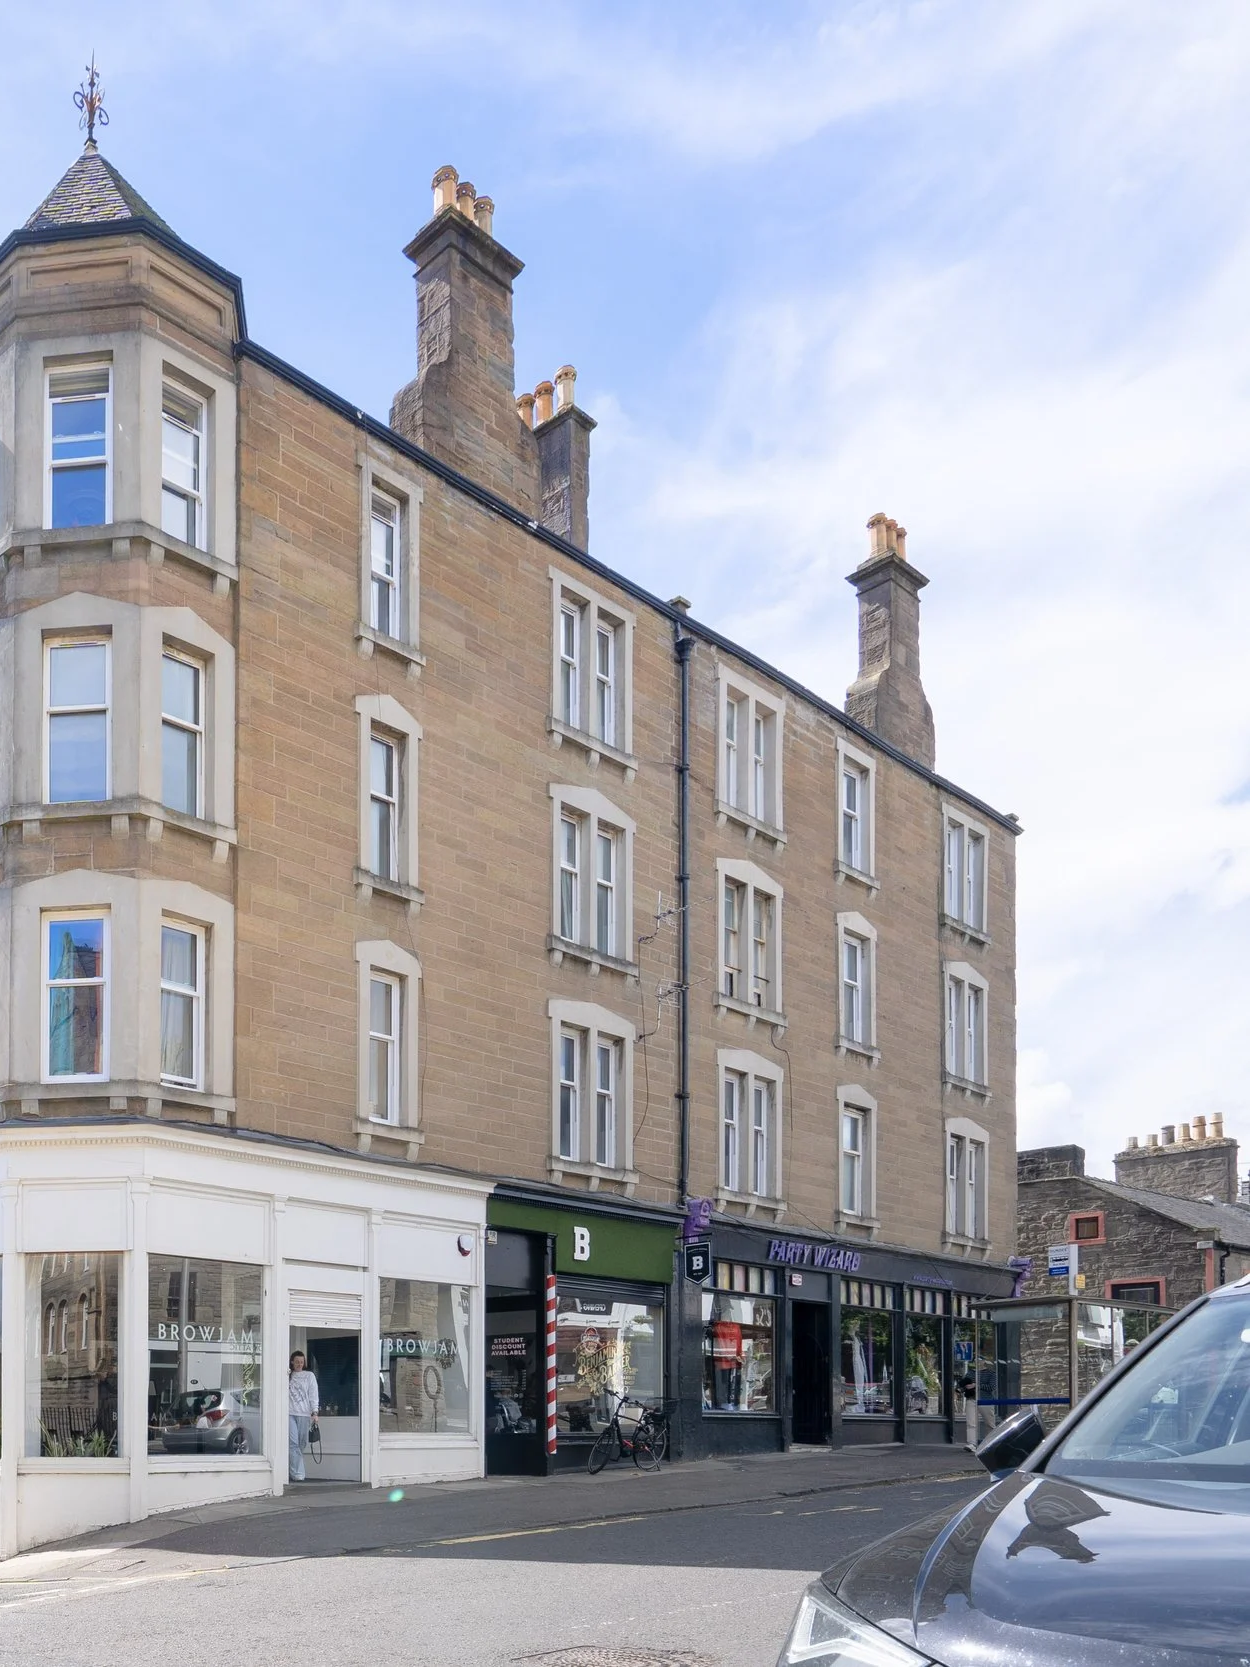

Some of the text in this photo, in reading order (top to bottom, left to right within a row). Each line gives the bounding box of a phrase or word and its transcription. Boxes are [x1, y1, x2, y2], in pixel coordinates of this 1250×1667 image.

[574, 1226, 590, 1261] B
[692, 1255, 703, 1270] B
[768, 1239, 861, 1273] PARTY WIZARD
[157, 1323, 254, 1344] BROWJAM
[388, 1338, 459, 1355] BROWJAM
